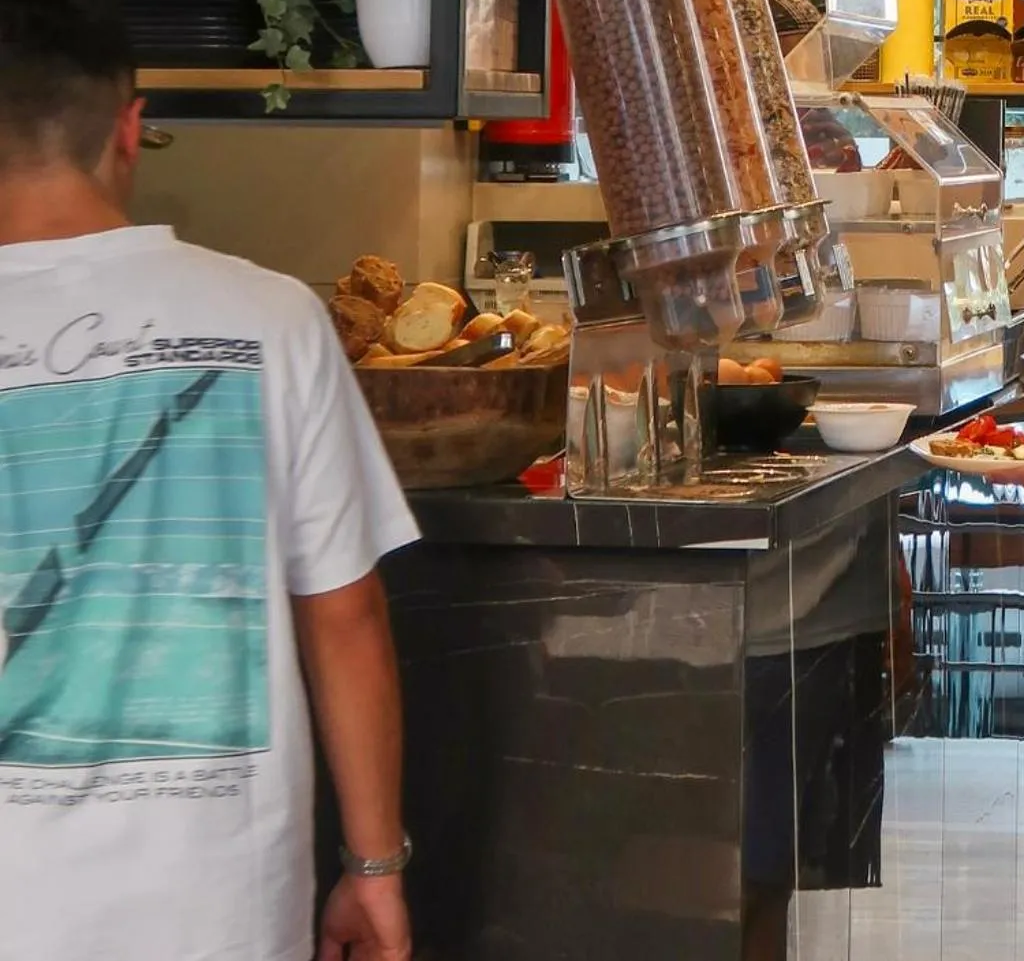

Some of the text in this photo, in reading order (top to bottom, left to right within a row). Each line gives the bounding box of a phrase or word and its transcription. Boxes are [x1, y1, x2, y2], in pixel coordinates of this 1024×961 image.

[964, 6, 995, 16] REAL
[152, 337, 262, 351] SUPERIOR
[123, 349, 263, 367] STANDARDS
[96, 787, 150, 802] YOUR
[155, 783, 241, 799] FRIENDS
